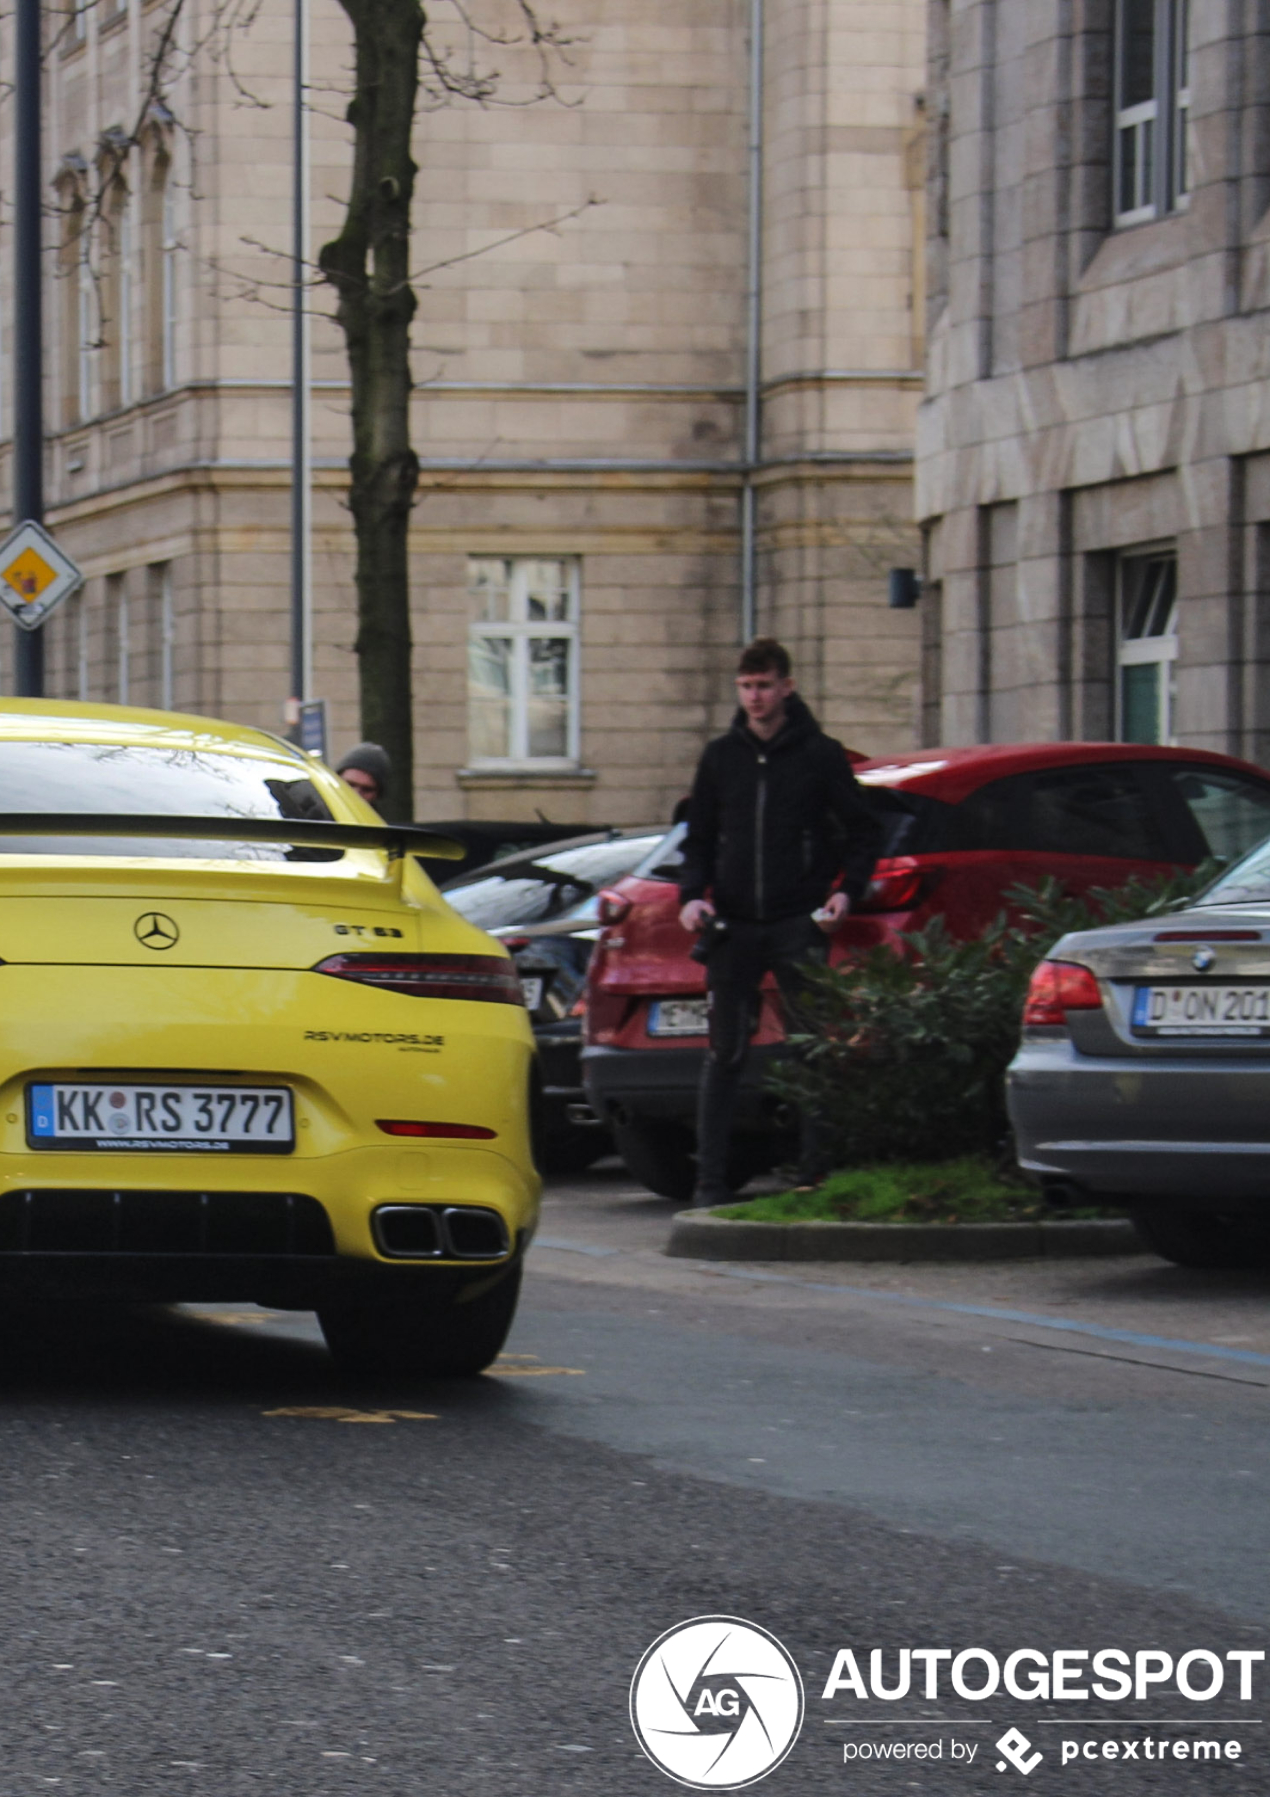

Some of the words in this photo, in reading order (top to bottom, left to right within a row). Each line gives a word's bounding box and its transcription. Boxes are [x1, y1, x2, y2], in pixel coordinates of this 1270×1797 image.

[335, 924, 366, 936] GT
[1150, 991, 1167, 1020] D
[304, 1030, 445, 1046] RSVMOTORS.DE
[57, 1090, 104, 1131] KK
[134, 1092, 182, 1132] RS
[192, 1093, 284, 1134] 3777
